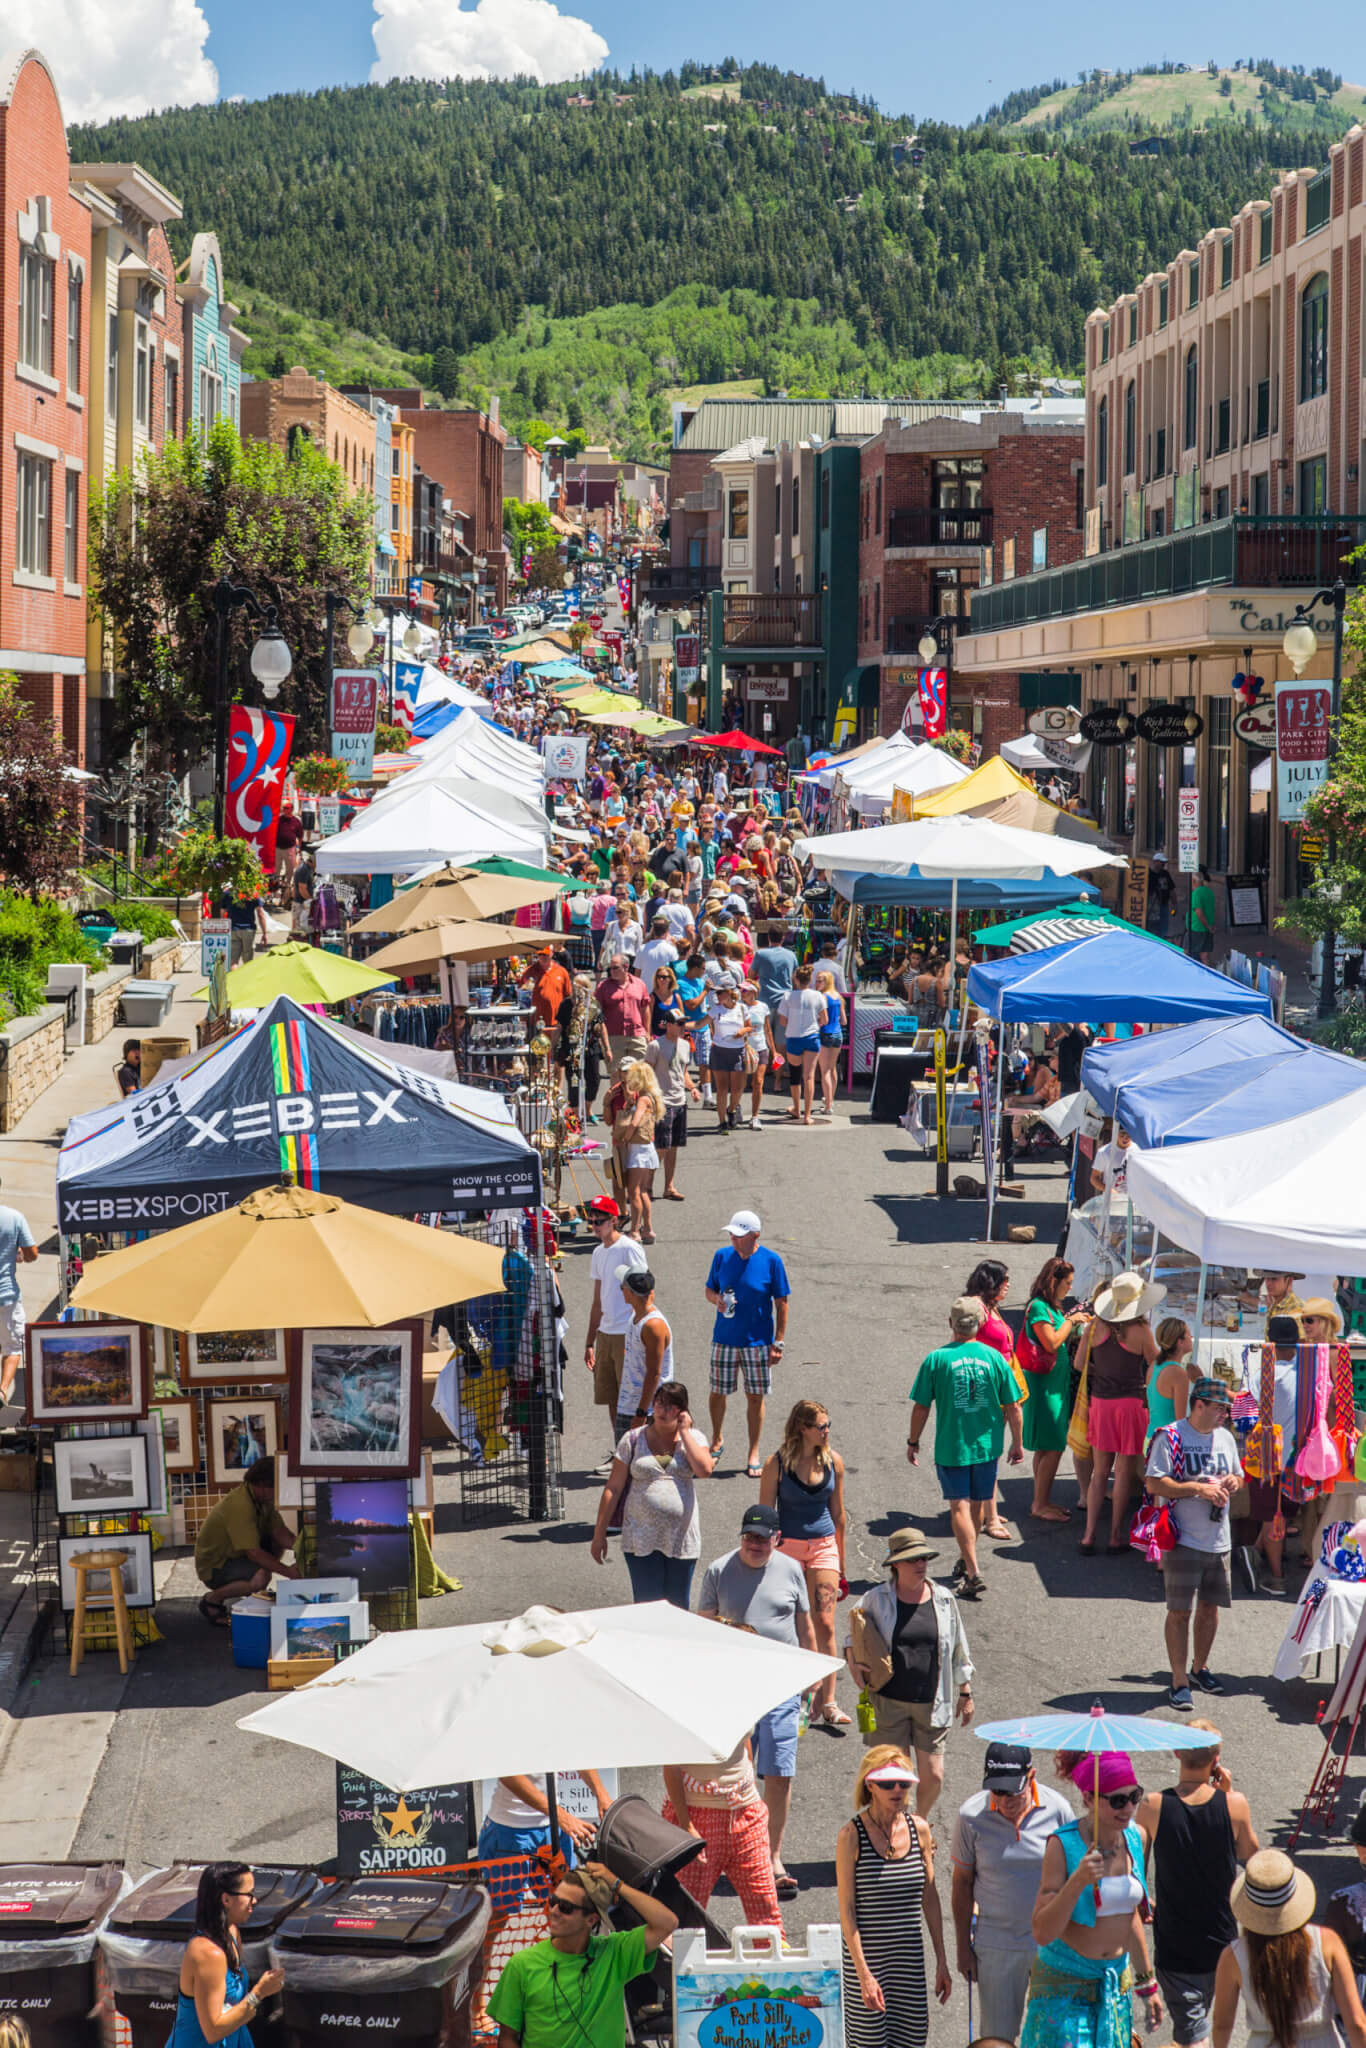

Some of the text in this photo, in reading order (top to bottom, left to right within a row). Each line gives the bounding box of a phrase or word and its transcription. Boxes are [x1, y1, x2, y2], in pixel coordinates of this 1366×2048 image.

[1230, 600, 1253, 610] The
[903, 672, 917, 680] TOW
[339, 737, 369, 751] JULY
[1287, 767, 1323, 784] JULY
[1128, 860, 1146, 892] ART
[185, 1089, 408, 1147] XEBEX
[452, 1172, 533, 1186] KNOW THE CODE
[64, 1191, 230, 1222] XEBEXSPORT
[1183, 1452, 1230, 1476] USA
[342, 1781, 366, 1793] PING
[373, 1790, 439, 1805] BAR OPEN
[338, 1809, 465, 1824] SPORTS MUSIC
[359, 1847, 447, 1869] SAPPORO
[348, 1894, 437, 1904] PAPER ONLY
[21, 1998, 52, 2008] ONLY
[320, 2013, 401, 2029] PAPER ONLY
[729, 2001, 792, 2032] Park Silly
[712, 2025, 812, 2048] Sunday Market
